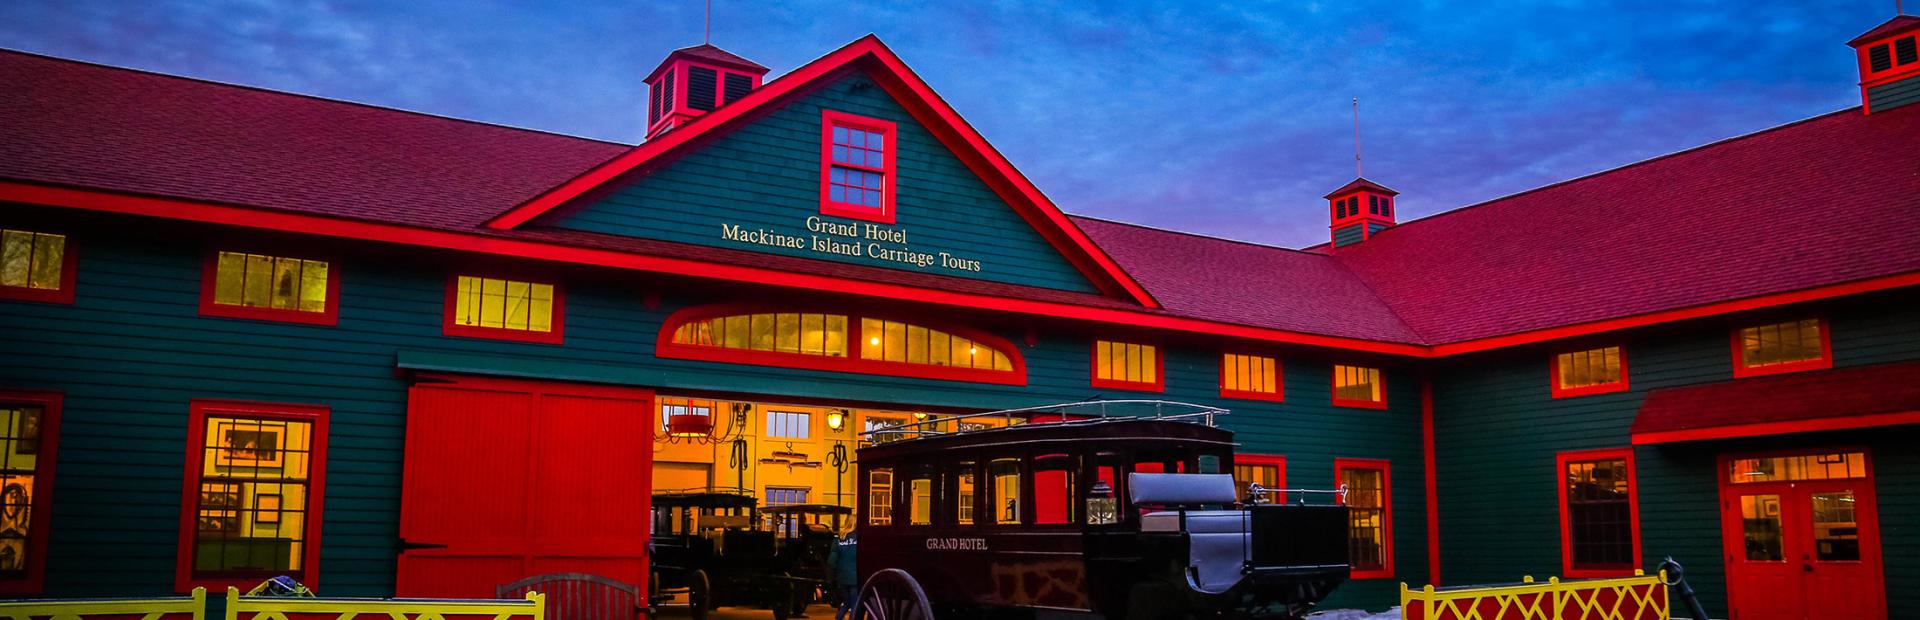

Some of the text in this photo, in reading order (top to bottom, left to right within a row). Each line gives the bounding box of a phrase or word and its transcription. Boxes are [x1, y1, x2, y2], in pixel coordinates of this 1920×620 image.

[806, 216, 907, 244] Grand Hotel
[721, 223, 981, 272] Mackinac Island Carriage Tours
[926, 538, 988, 550] GRAND HOTEL
